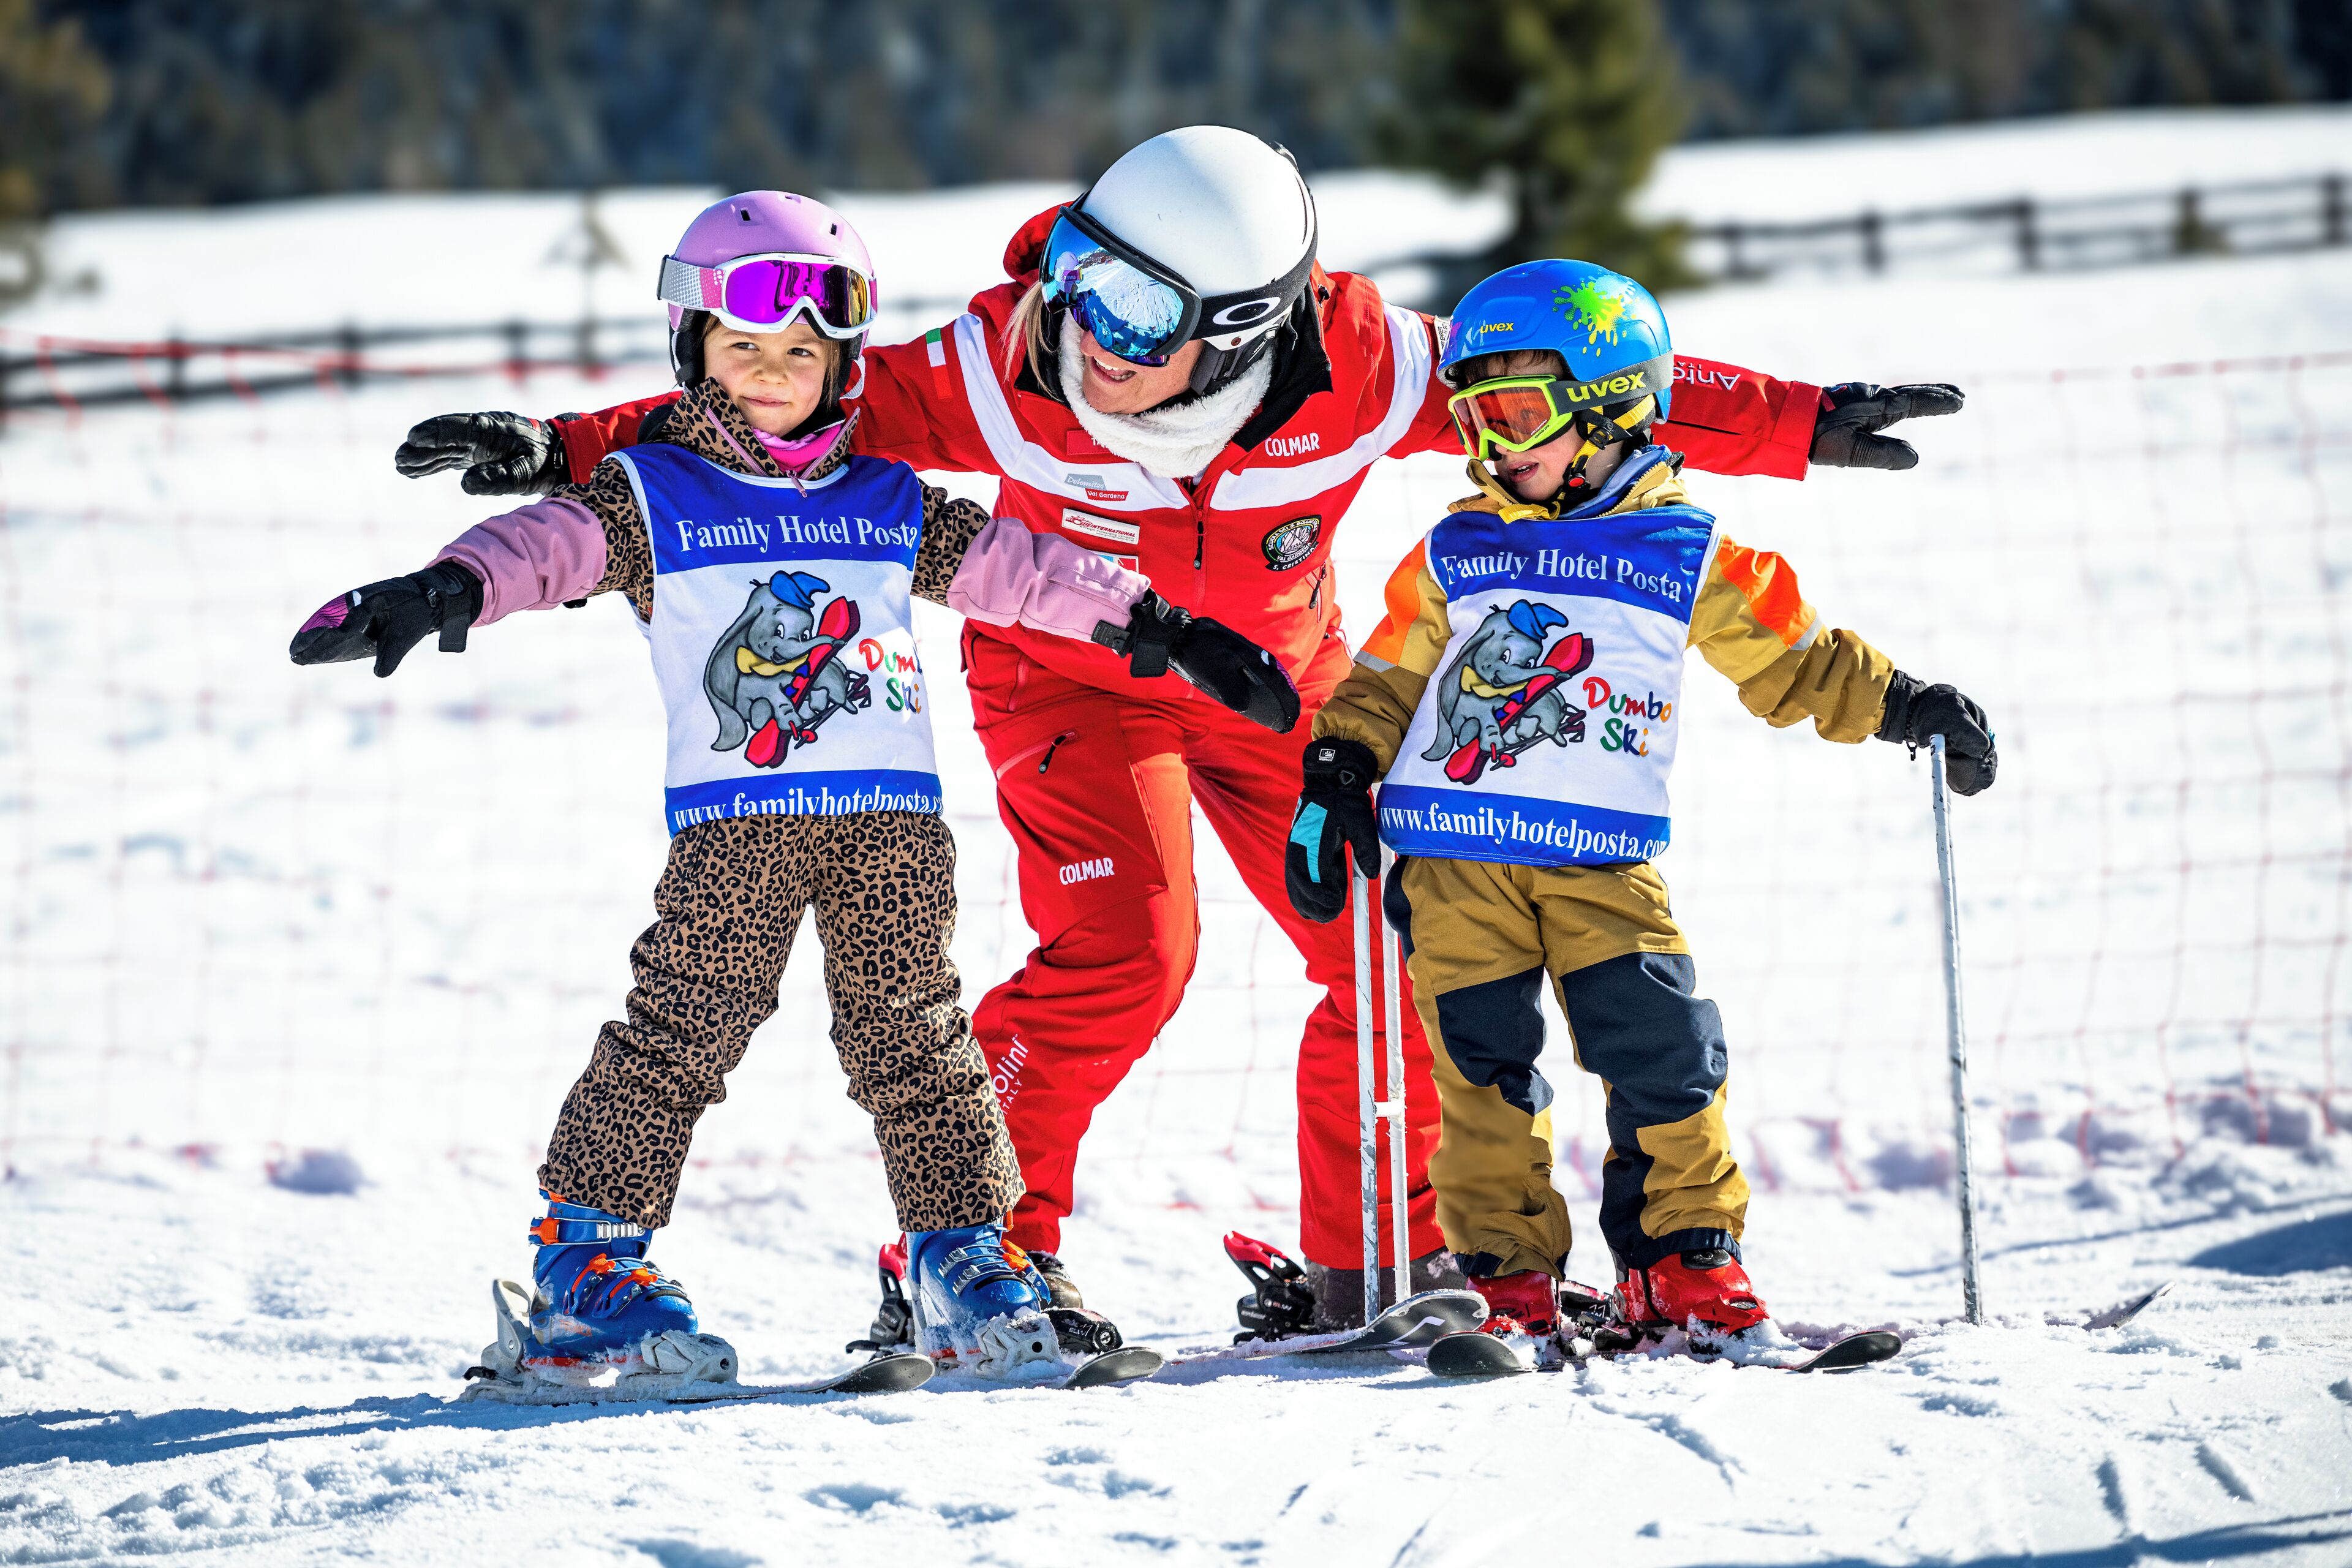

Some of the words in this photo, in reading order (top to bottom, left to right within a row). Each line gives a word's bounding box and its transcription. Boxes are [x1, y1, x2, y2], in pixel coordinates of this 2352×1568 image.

[1480, 323, 1514, 334] uvex
[1566, 372, 1646, 402] uvex
[1673, 367, 1741, 390] Anto
[1265, 432, 1320, 456] COLMAR
[1067, 475, 1104, 489] Dolomites
[676, 517, 771, 553] Family
[775, 516, 852, 544] Hotel
[853, 518, 918, 549] Posta
[1090, 524, 1136, 537] INTERNATIONAL
[1441, 551, 1529, 586] Family
[1534, 549, 1608, 580] Hotel
[1616, 557, 1681, 602] Posta
[859, 638, 922, 674] Dum
[886, 677, 922, 714] Ski
[1583, 676, 1672, 723] Dumbo
[1600, 718, 1649, 757] Ski
[1059, 857, 1115, 886] COLMAR
[992, 1034, 1029, 1102] olini
